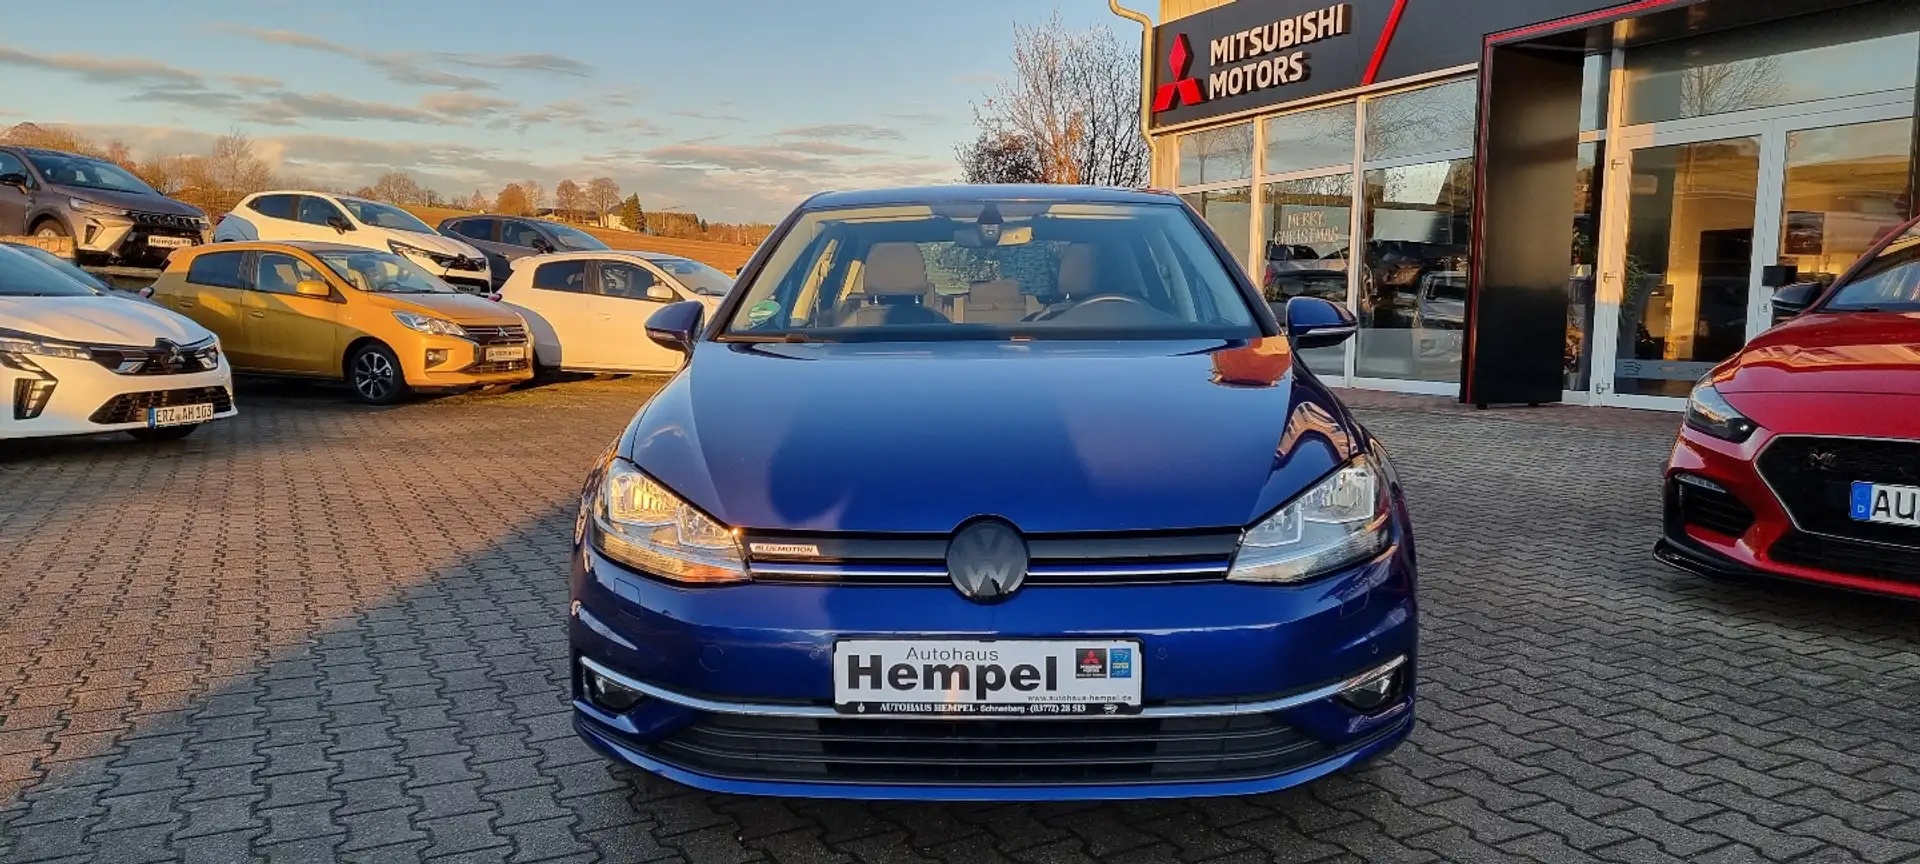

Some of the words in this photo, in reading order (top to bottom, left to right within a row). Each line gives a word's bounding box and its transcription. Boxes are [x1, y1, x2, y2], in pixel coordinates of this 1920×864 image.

[1210, 3, 1344, 67] MITSUBISHI
[1209, 50, 1304, 100] MOTORS
[1288, 210, 1325, 229] MERRY
[1274, 226, 1339, 246] CHRISTMAS
[156, 408, 175, 423] ERZ
[1871, 489, 1917, 520] AU
[755, 545, 814, 553] BLUEMOTION
[906, 647, 999, 661] Autohaus
[848, 655, 1057, 701] Hempel
[880, 703, 932, 712] AUTOHAUS
[934, 703, 975, 712] HEMPEL
[1061, 704, 1070, 712] 28
[1072, 704, 1086, 712] 513
[1027, 694, 1132, 704] www.autohaus-hempel.de
